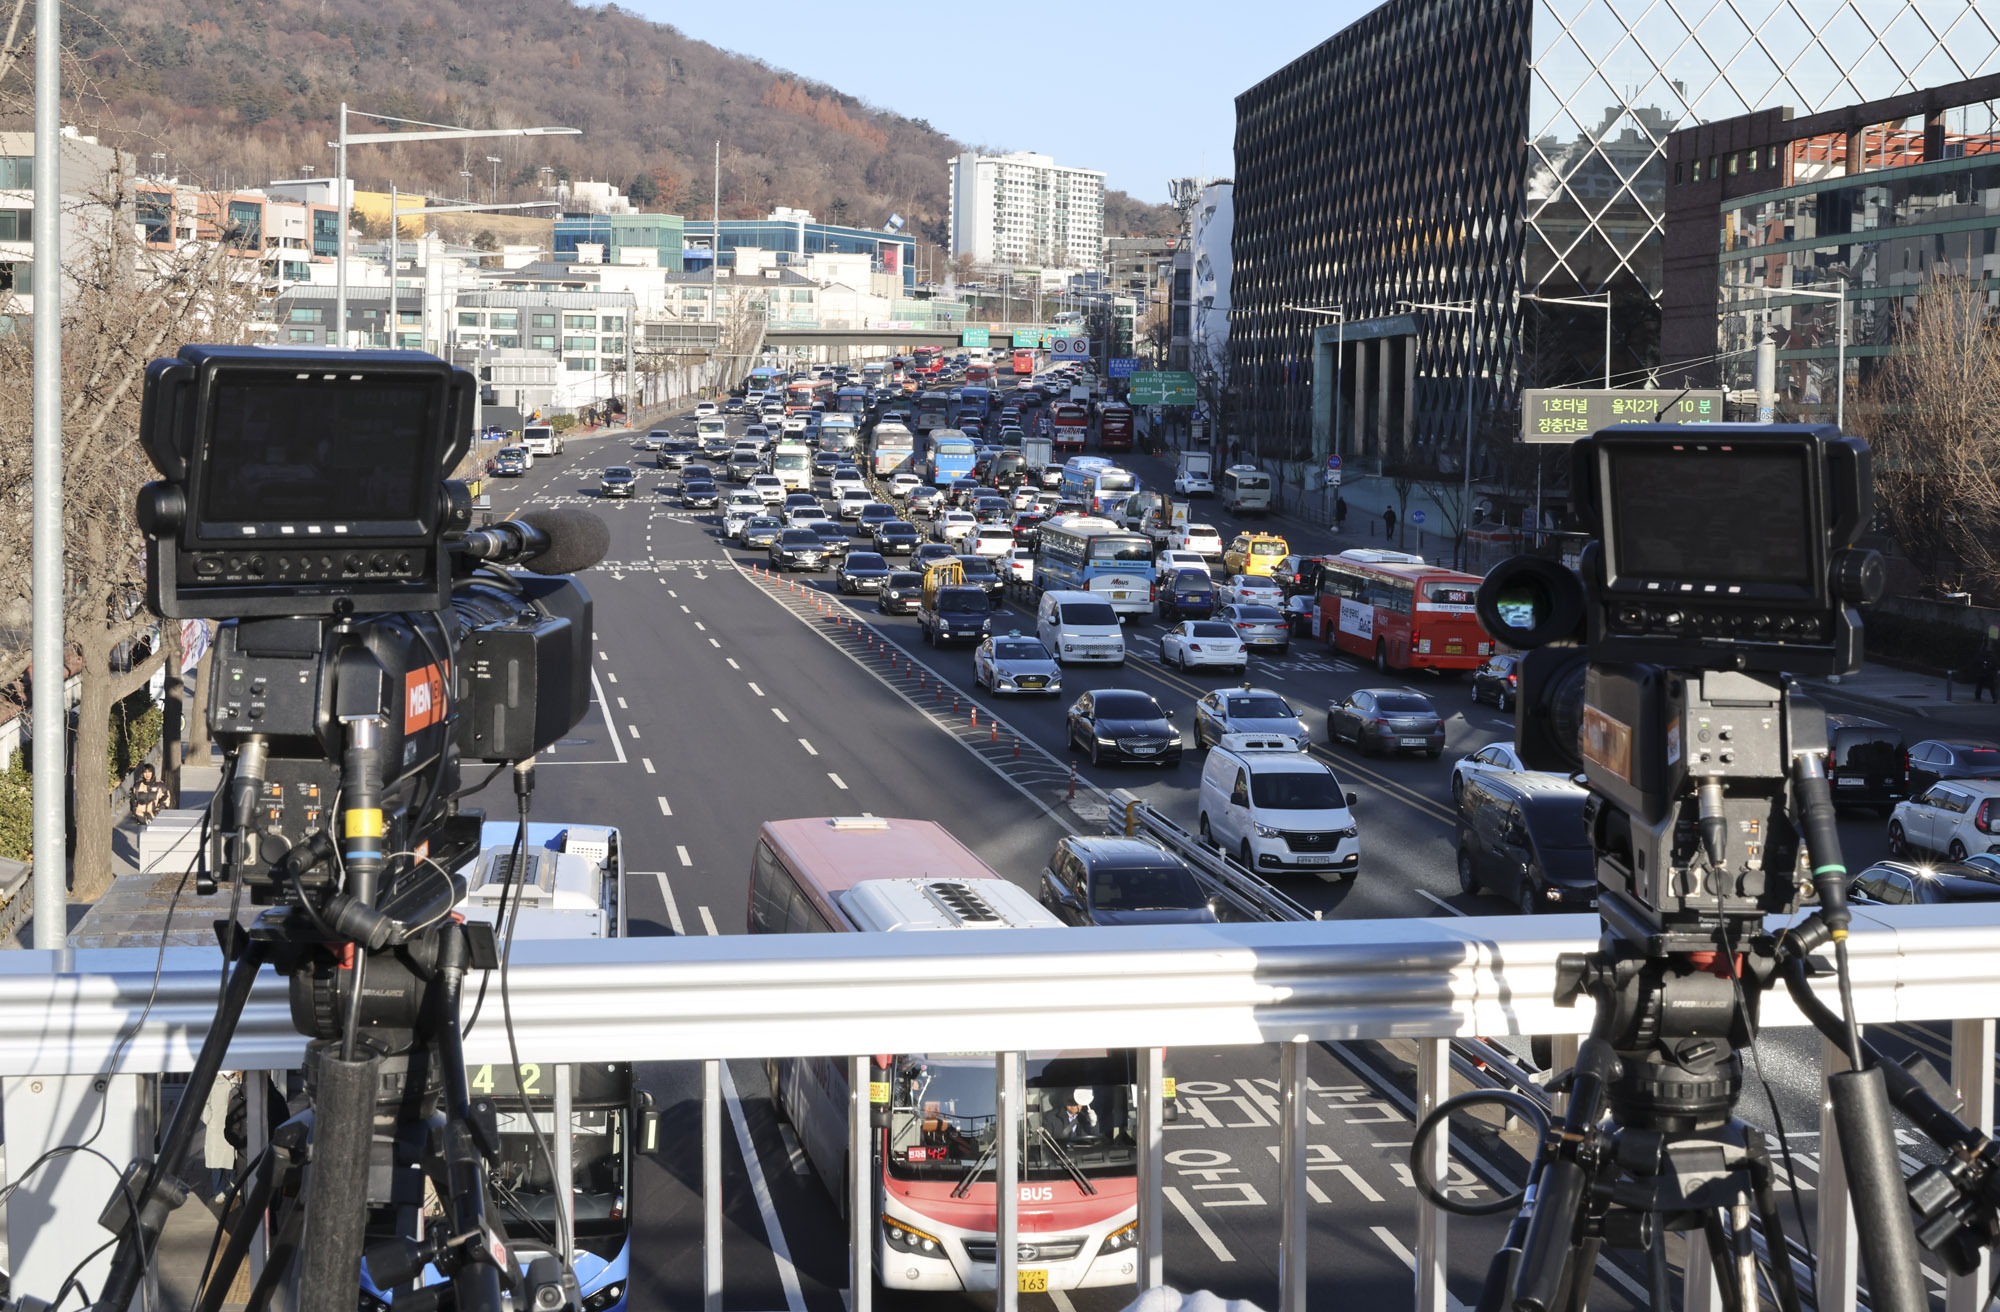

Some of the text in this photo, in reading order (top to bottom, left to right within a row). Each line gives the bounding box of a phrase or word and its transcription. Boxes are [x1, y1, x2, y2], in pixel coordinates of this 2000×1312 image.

[1542, 399, 1711, 414] 1호터널 을지2가 10 분
[1538, 418, 1588, 433] 장충단로
[1020, 1187, 1052, 1201] BUS
[1021, 1279, 1045, 1290] 163
